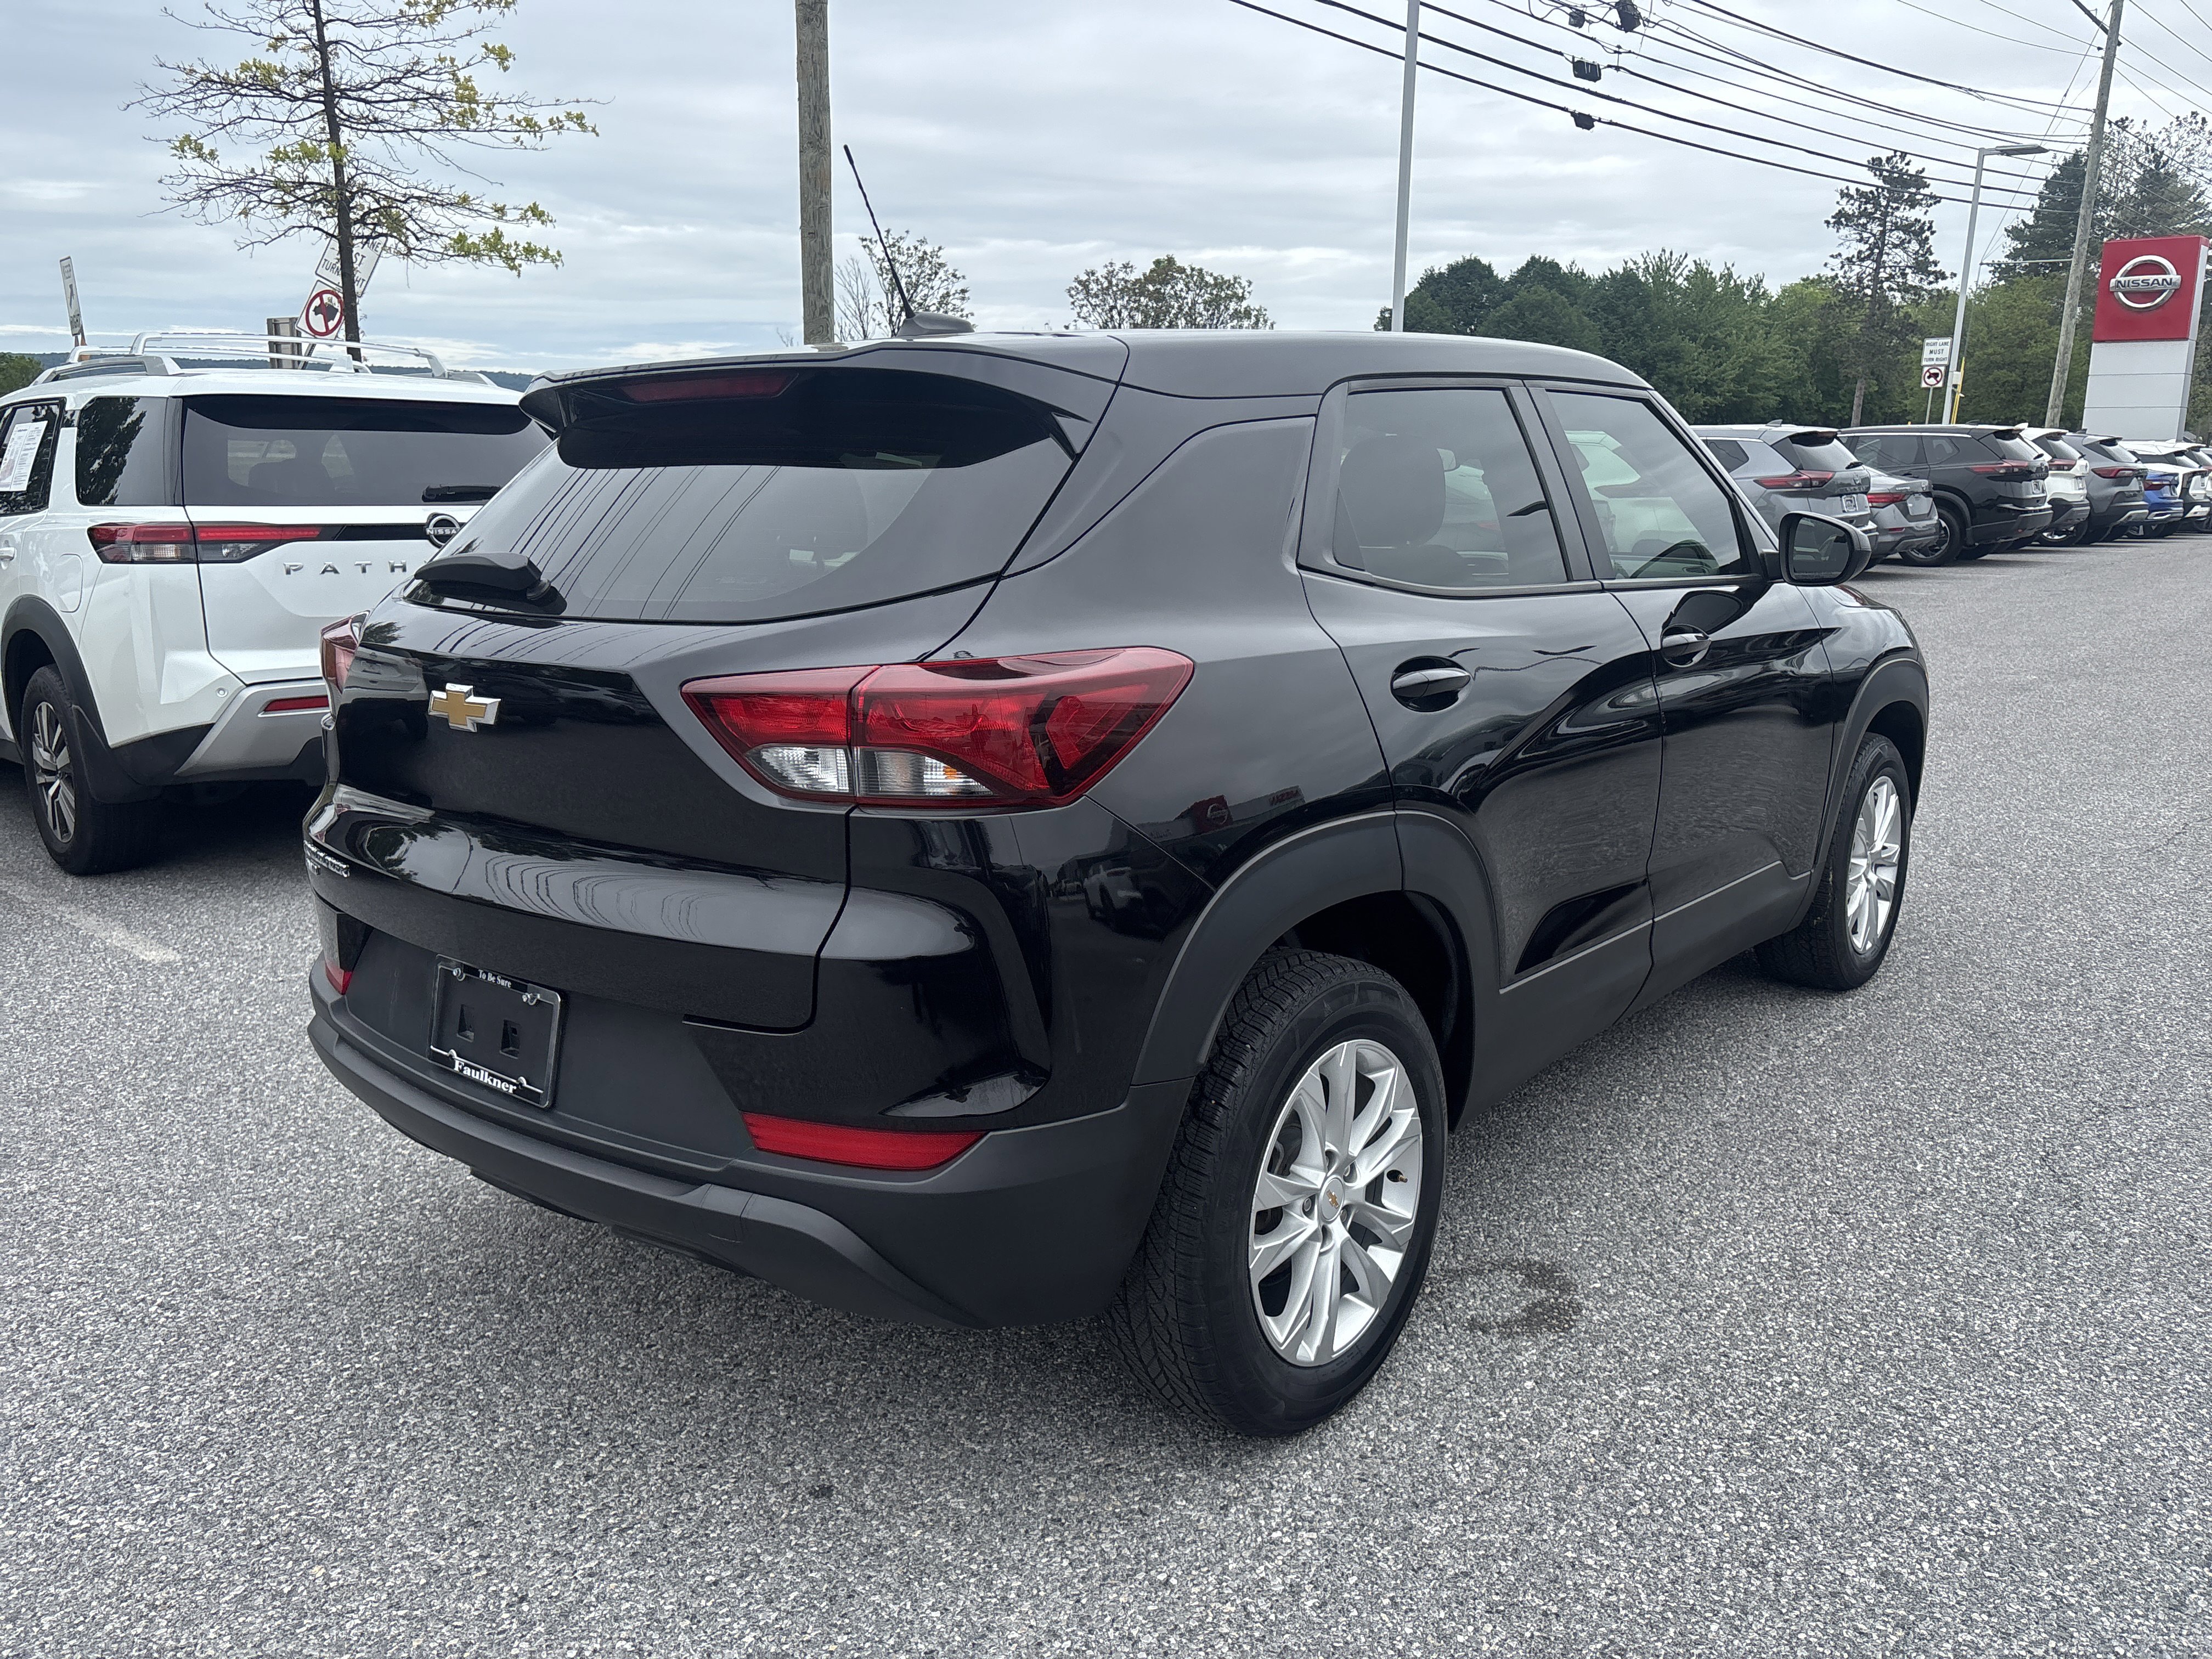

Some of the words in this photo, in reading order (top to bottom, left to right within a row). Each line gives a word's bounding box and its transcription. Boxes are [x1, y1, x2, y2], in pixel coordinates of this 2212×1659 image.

[2116, 278, 2172, 288] NISSAN
[283, 560, 407, 575] PATH
[478, 969, 486, 979] To
[487, 973, 496, 983] Be
[496, 975, 512, 988] Sure
[453, 1060, 517, 1094] Faulkner
